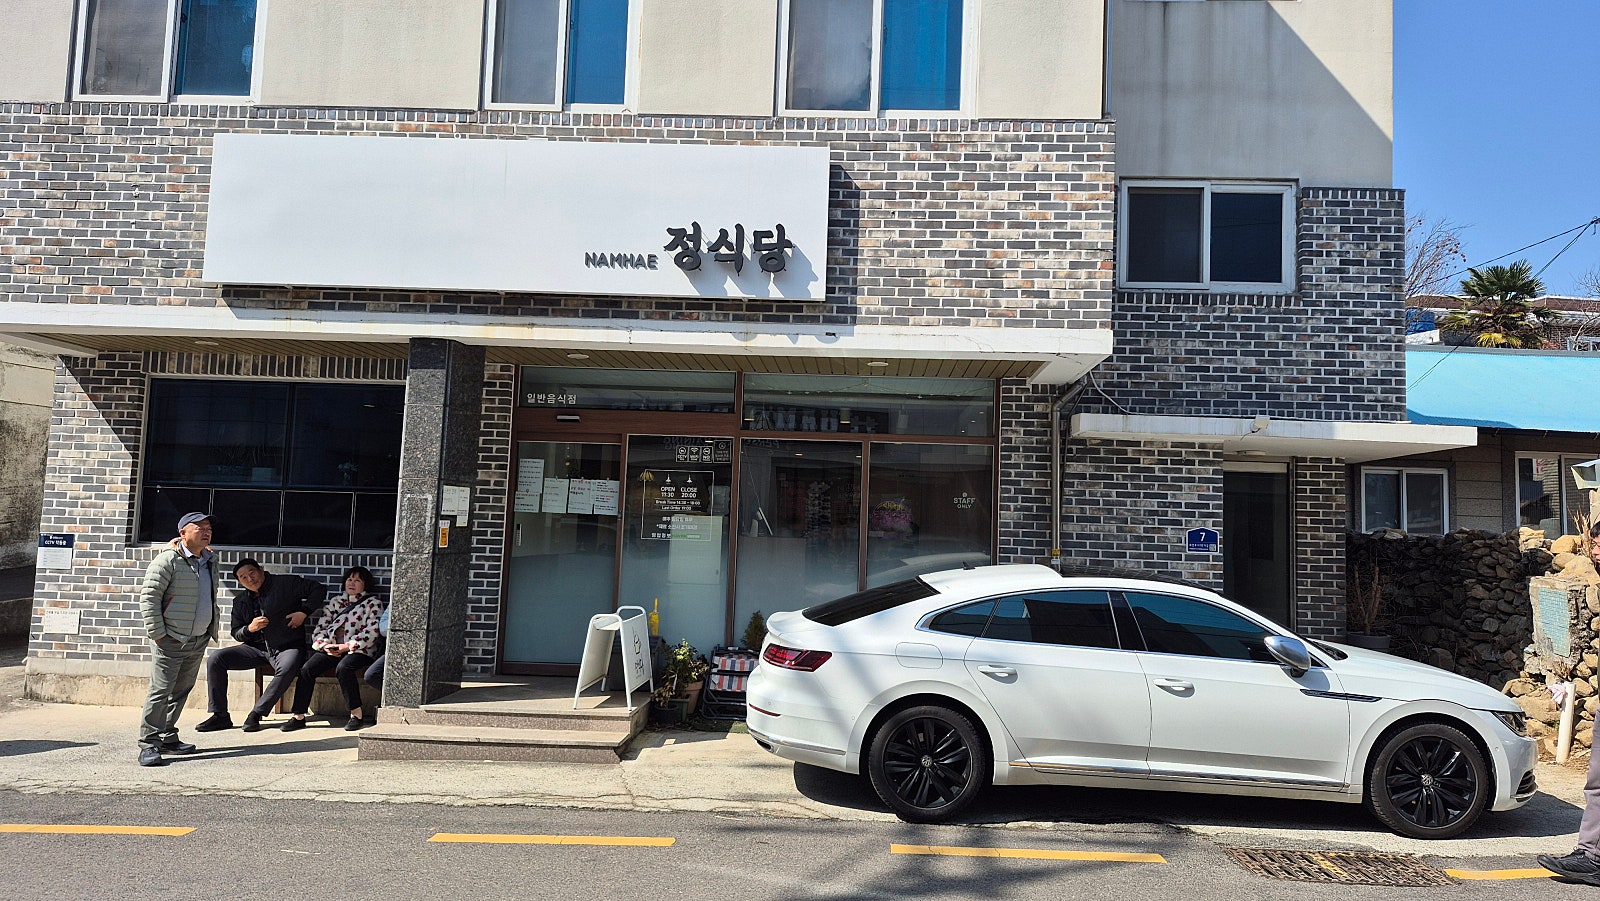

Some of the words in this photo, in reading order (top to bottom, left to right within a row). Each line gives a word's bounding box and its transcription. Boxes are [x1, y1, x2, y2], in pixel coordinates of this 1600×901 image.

[663, 221, 795, 276] 정식당
[584, 251, 658, 271] NAMHAE
[527, 393, 577, 404] 일반음식점
[1199, 532, 1206, 542] 7
